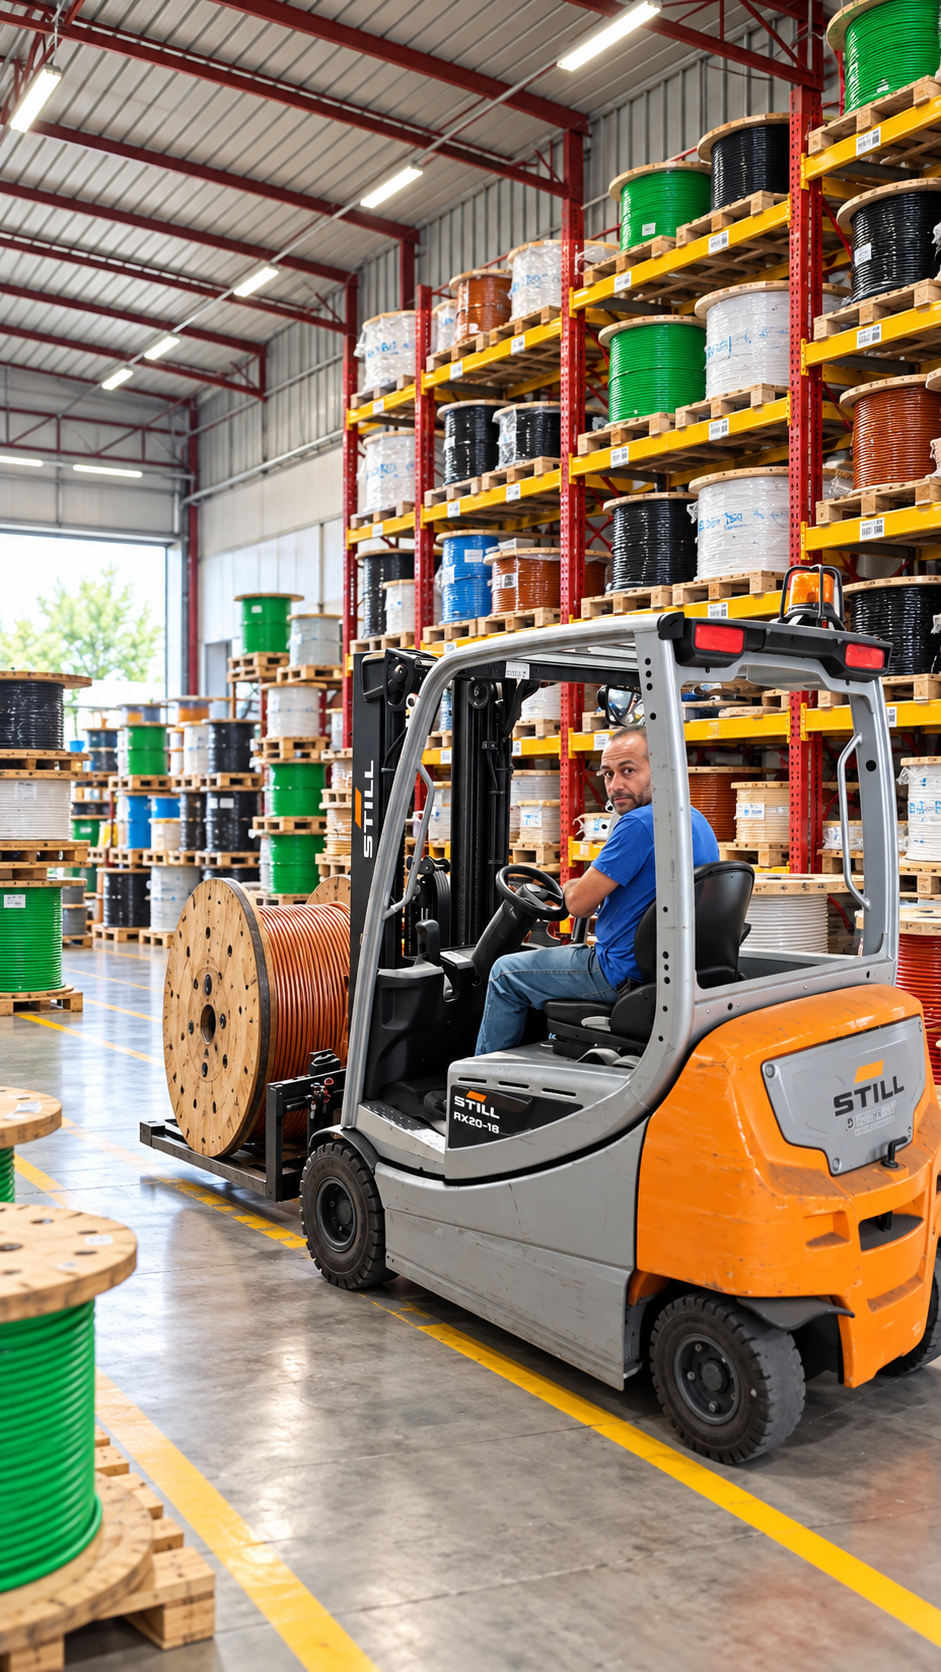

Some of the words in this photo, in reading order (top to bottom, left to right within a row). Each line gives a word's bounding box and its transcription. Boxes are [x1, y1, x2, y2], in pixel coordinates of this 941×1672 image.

[363, 760, 374, 858] STILL
[454, 1095, 500, 1120] STILL
[833, 1075, 905, 1117] STILL
[453, 1111, 500, 1134] RX20-18
